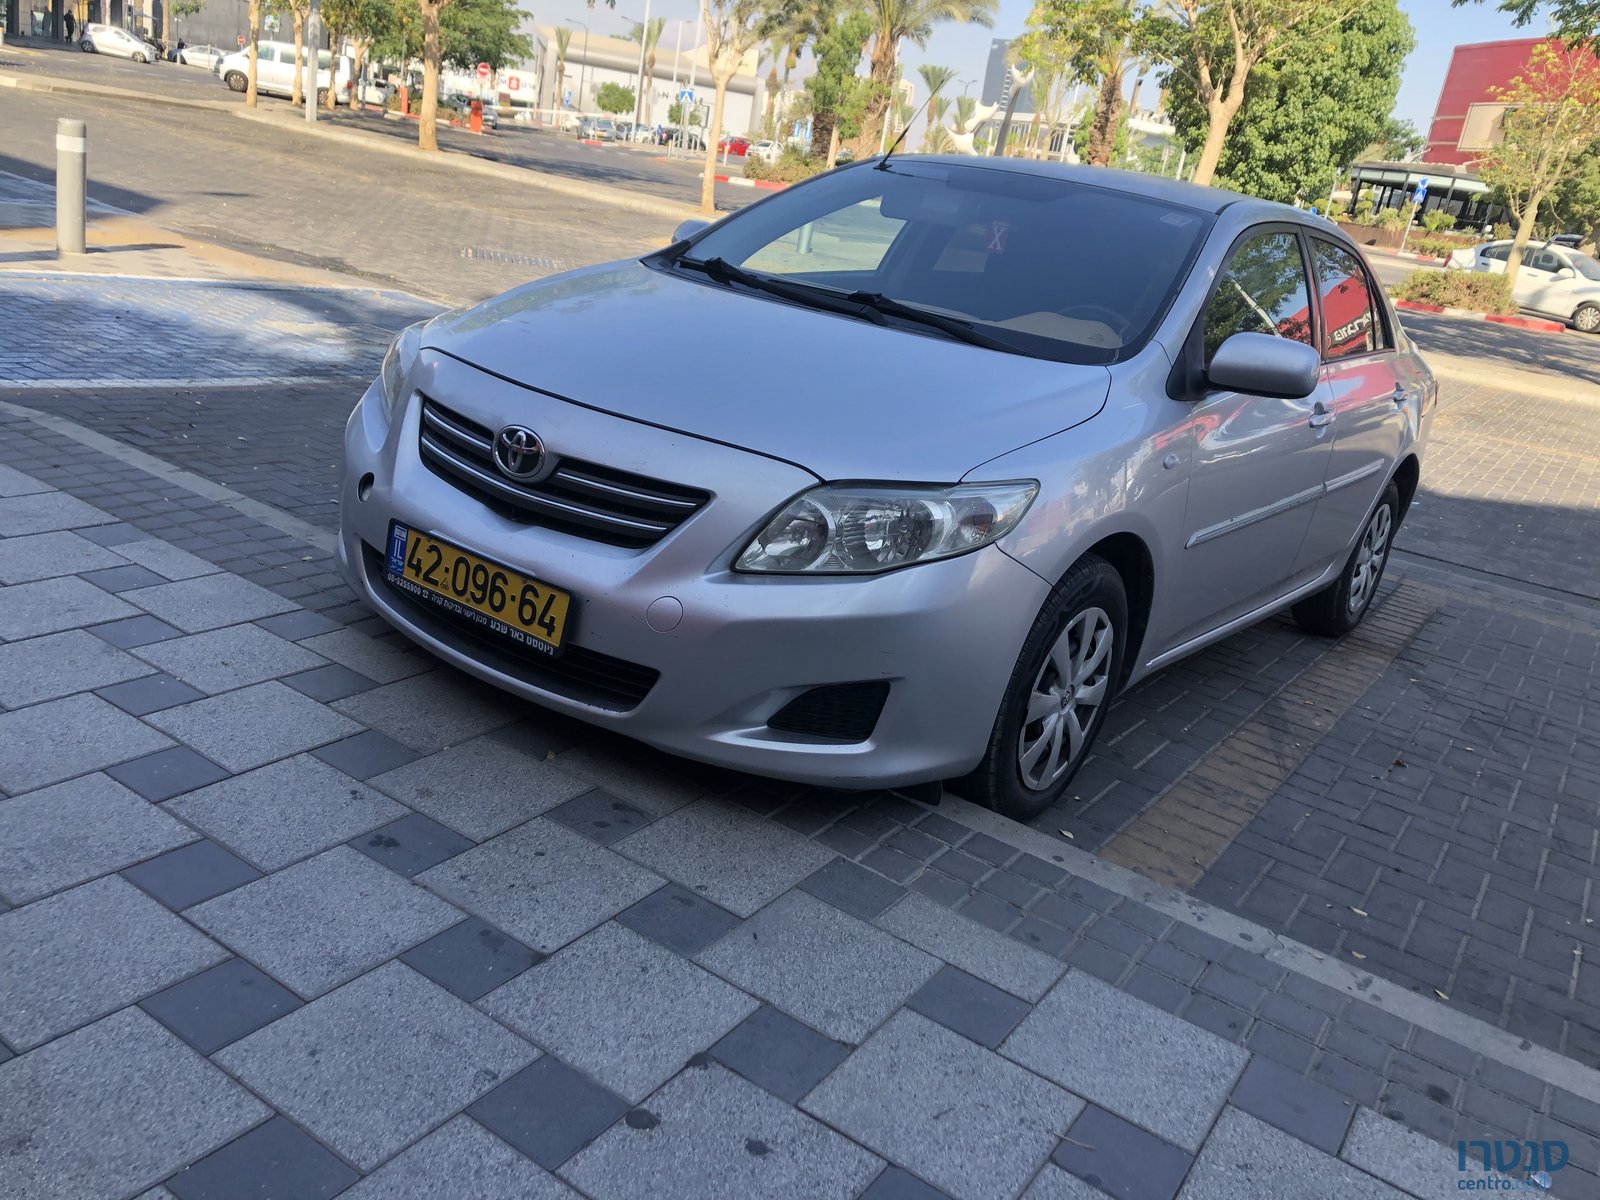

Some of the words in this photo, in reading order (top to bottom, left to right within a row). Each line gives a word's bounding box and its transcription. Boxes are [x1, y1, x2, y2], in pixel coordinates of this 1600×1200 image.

[393, 538, 403, 560] IL
[490, 619, 508, 634] שבע
[510, 628, 524, 642] באר
